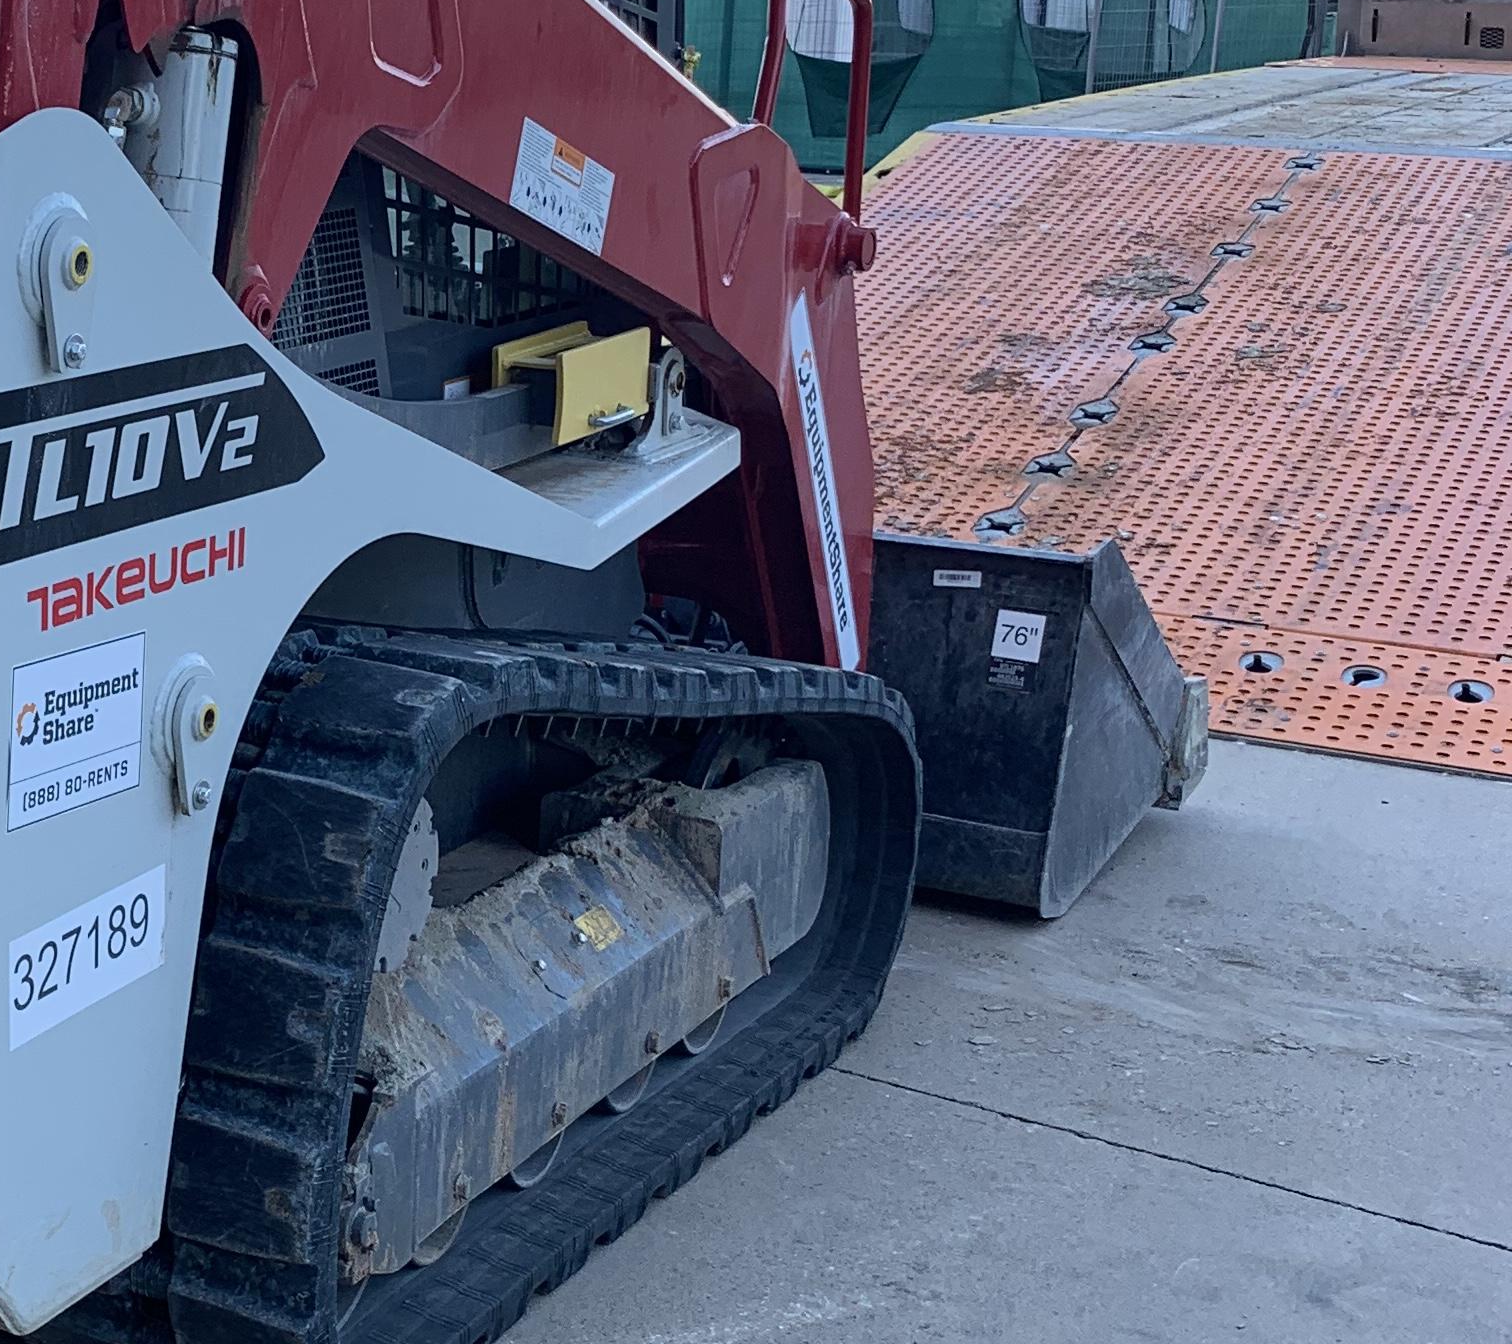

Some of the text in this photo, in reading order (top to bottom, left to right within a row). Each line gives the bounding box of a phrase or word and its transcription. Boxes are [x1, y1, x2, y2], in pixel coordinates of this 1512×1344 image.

[1001, 623, 1039, 646] 76"
[43, 667, 139, 717] Equipment
[42, 712, 95, 745] Share
[22, 759, 129, 812] (888) 80-RENTS
[13, 892, 149, 1011] 327189
